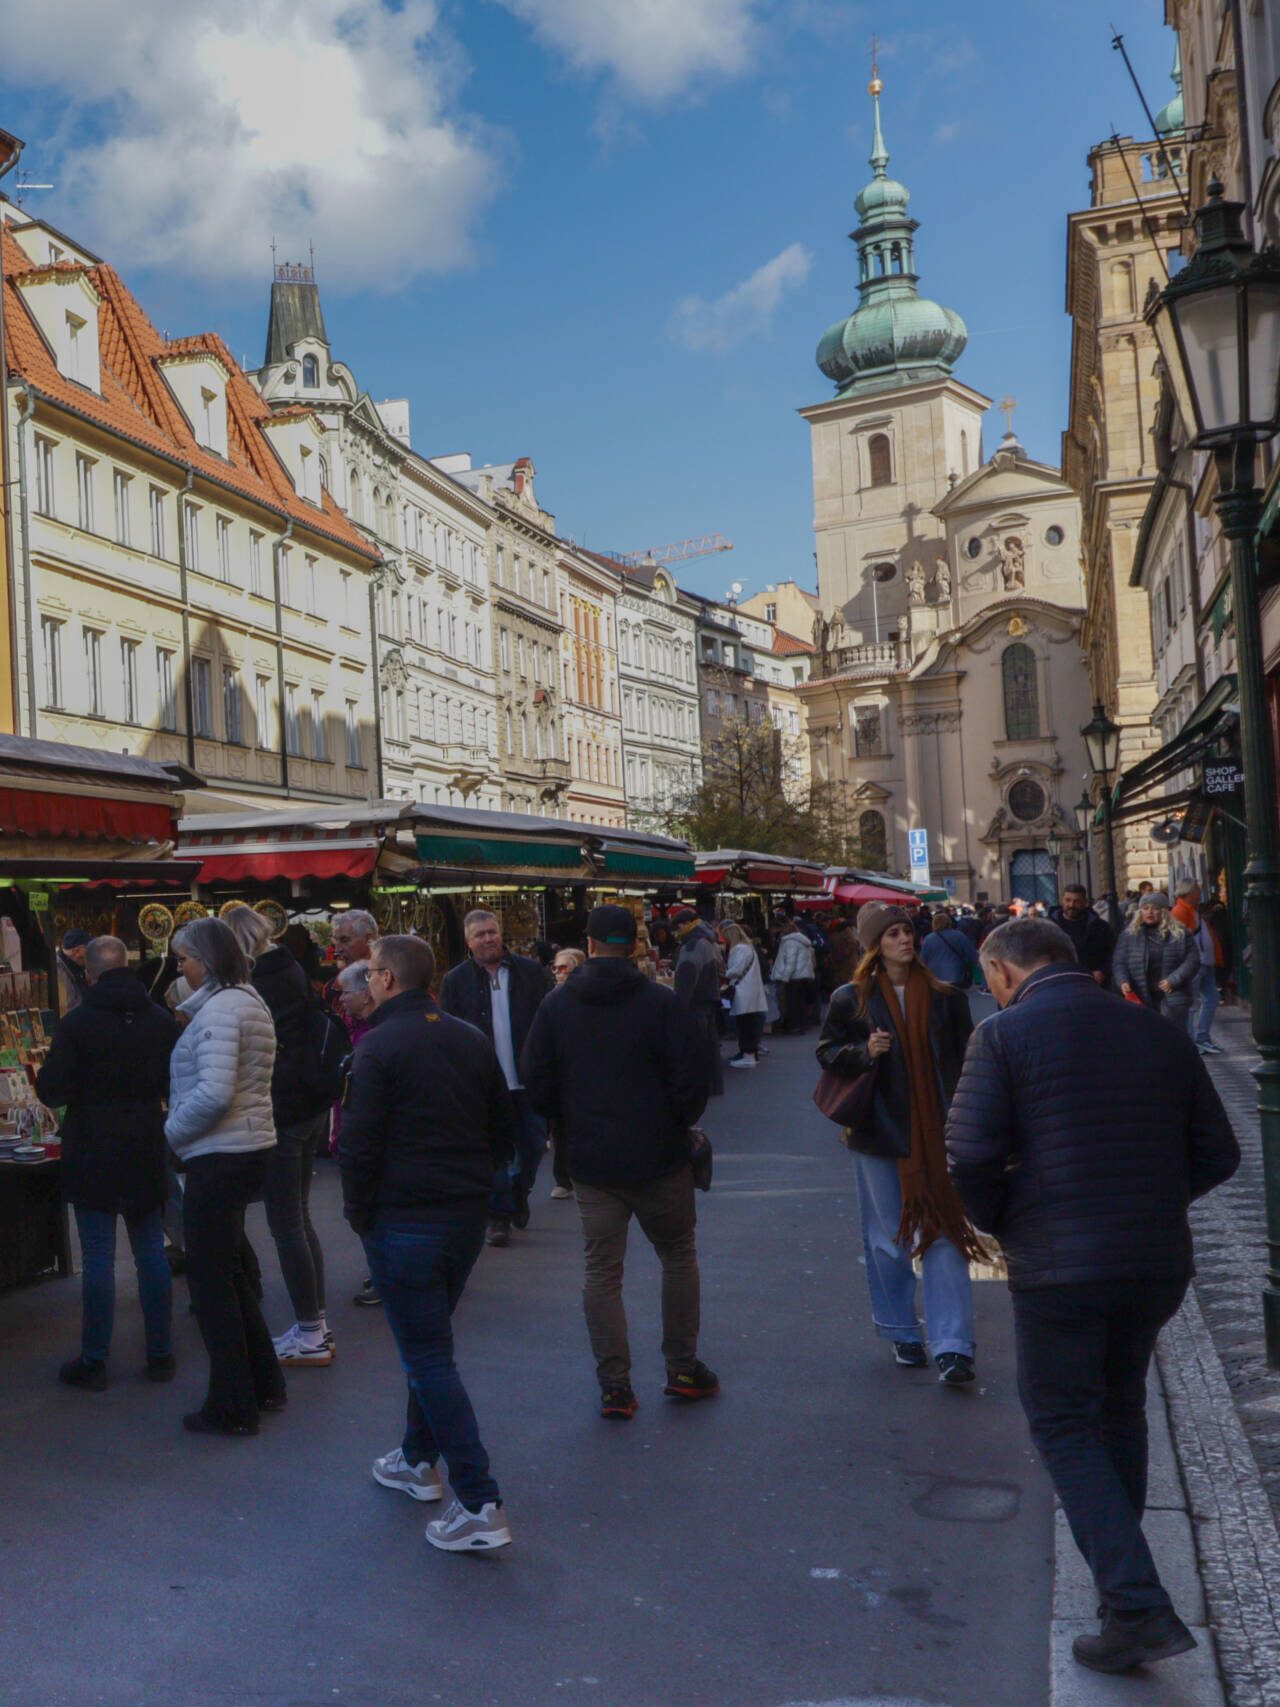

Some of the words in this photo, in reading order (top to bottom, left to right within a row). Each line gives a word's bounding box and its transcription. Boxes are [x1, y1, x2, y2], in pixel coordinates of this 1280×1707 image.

[1205, 766, 1236, 776] SHOP
[1207, 784, 1235, 793] CAFE
[913, 848, 924, 861] P
